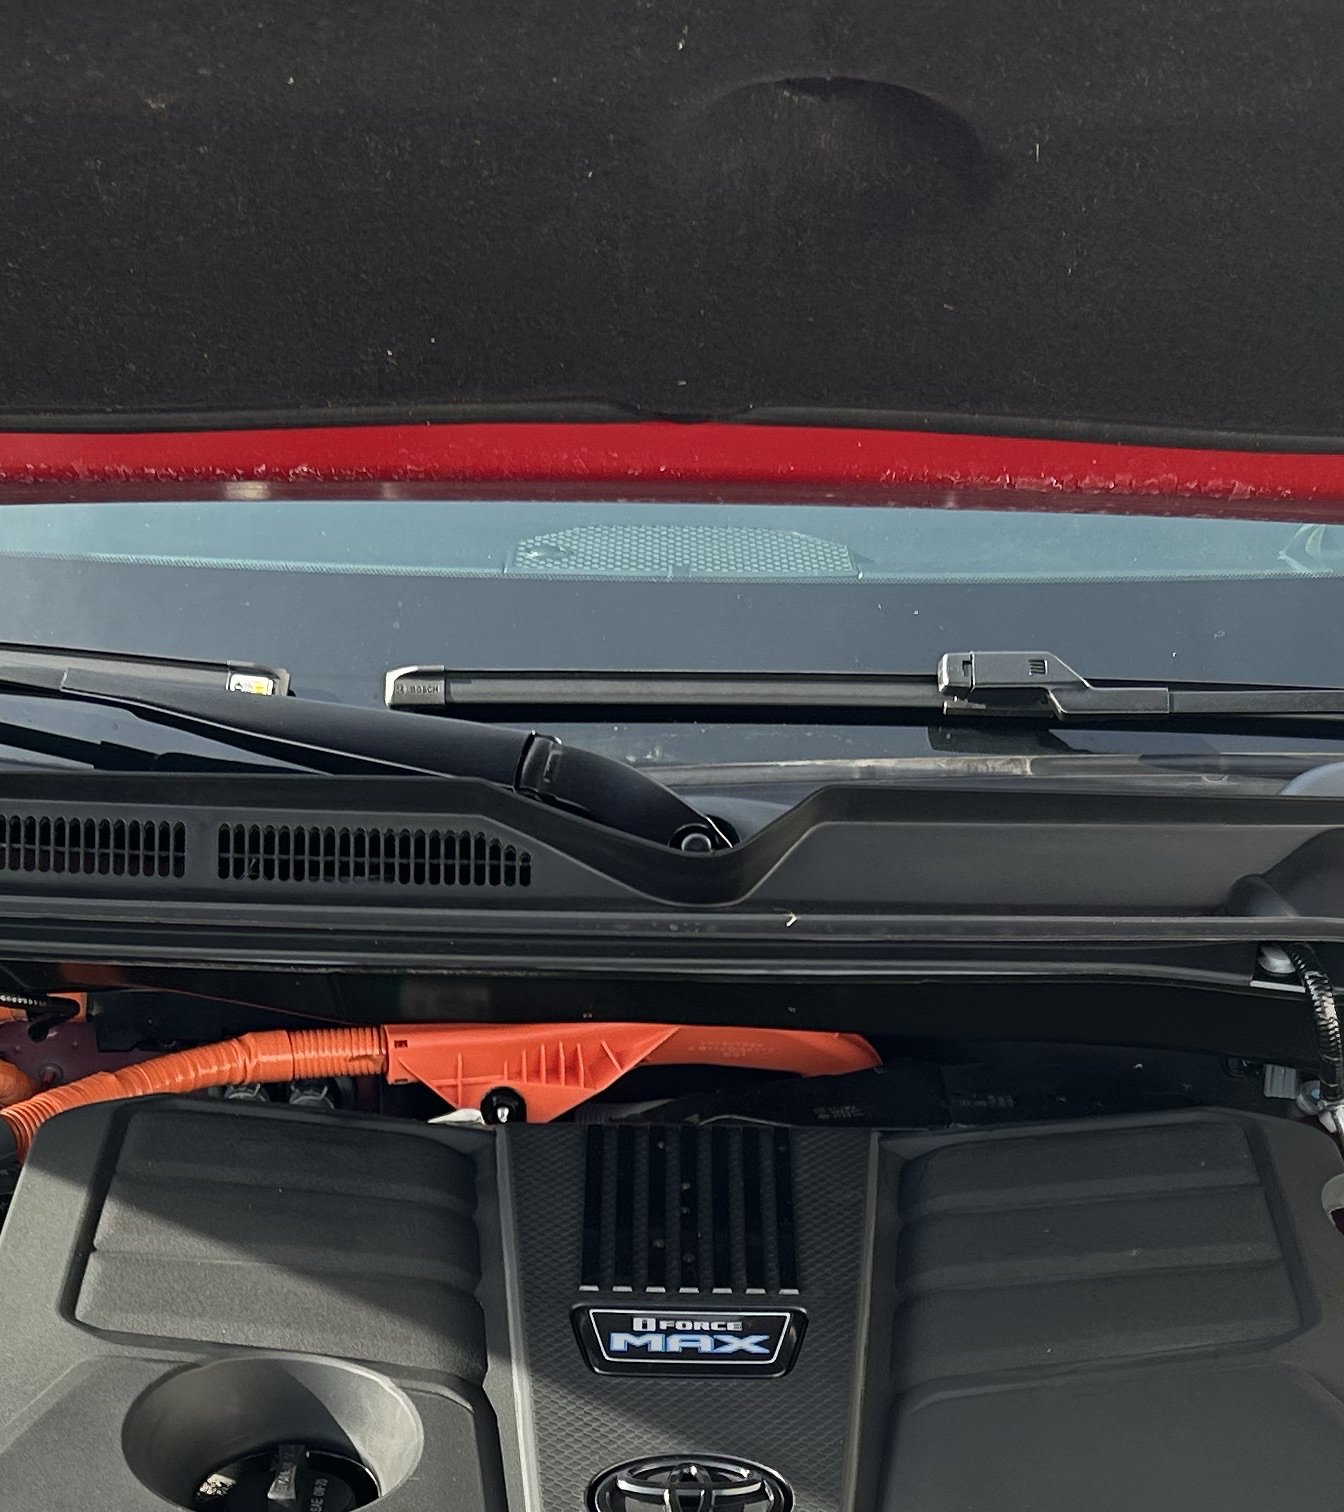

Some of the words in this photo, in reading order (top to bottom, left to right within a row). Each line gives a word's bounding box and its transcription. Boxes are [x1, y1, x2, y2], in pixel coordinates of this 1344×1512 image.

[409, 685, 440, 694] BOSCH
[659, 1320, 743, 1331] FORCE
[609, 1332, 771, 1354] MAX
